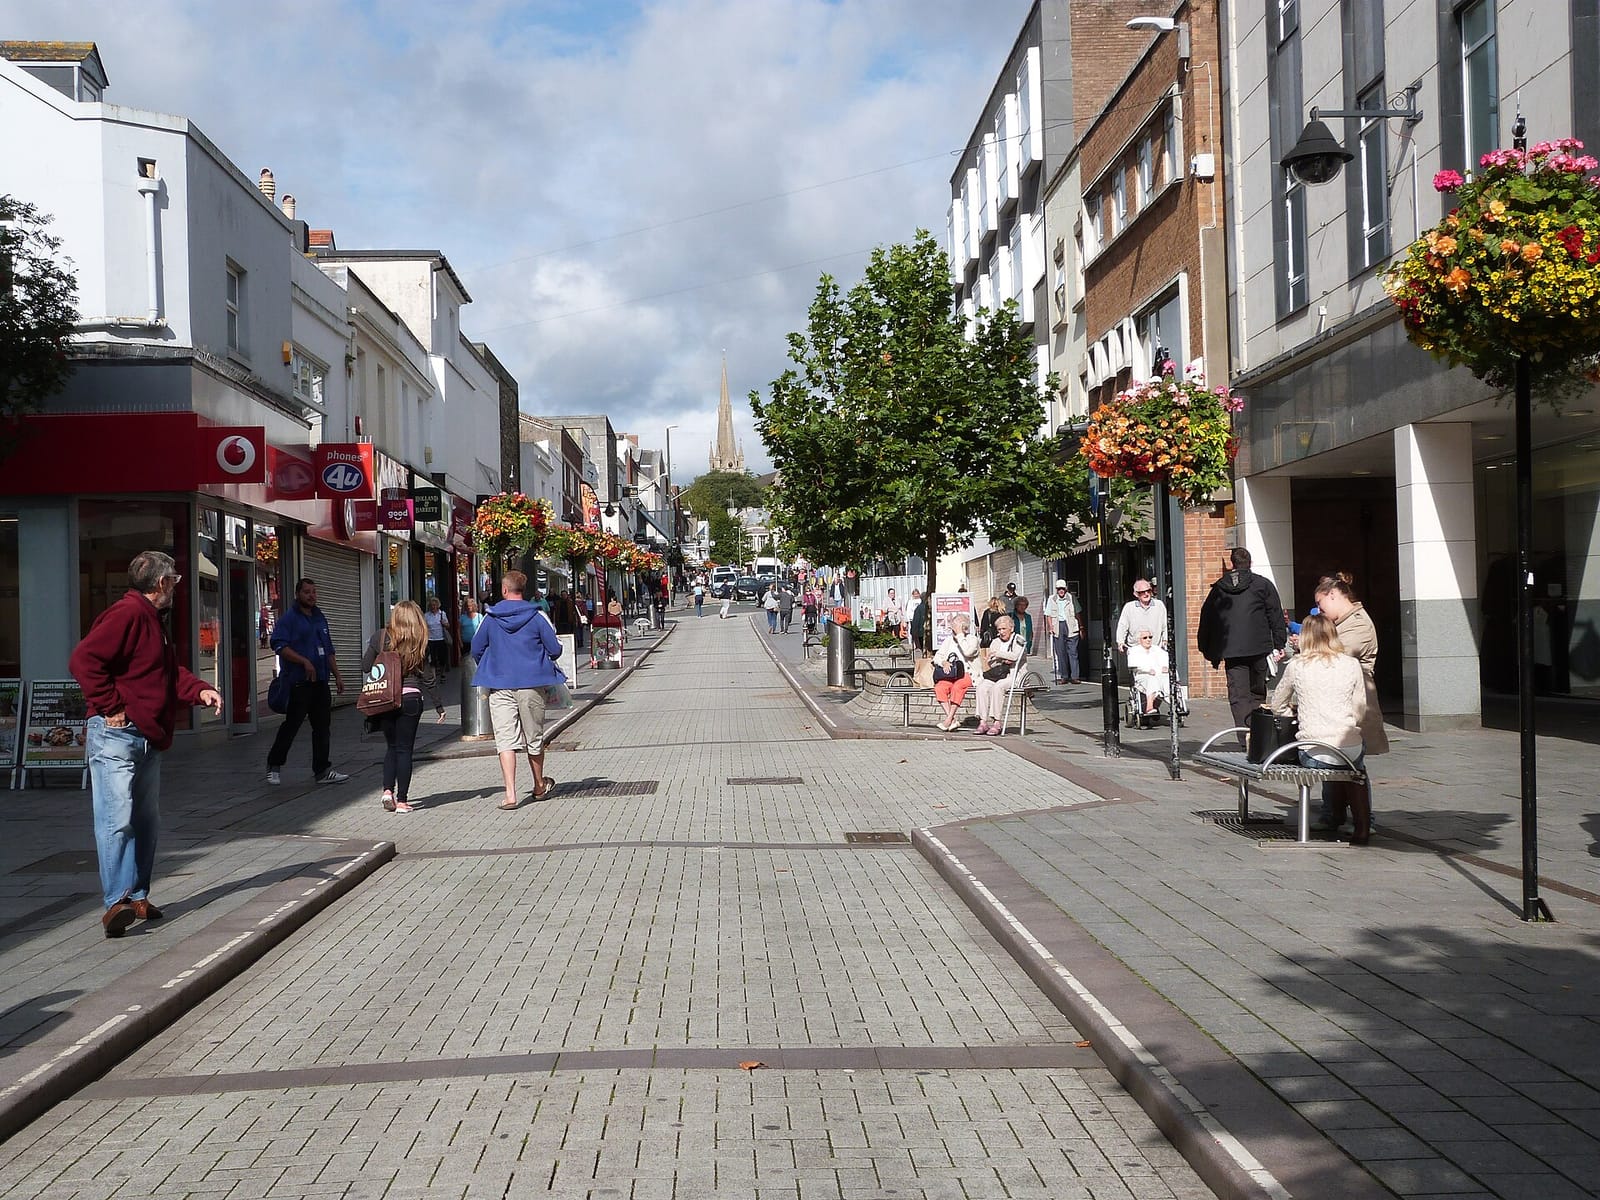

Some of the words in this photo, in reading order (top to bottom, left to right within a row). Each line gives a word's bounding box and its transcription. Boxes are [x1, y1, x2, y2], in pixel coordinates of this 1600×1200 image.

[327, 450, 363, 462] phones
[327, 465, 360, 489] 4u
[388, 509, 408, 519] good
[362, 680, 388, 692] animal
[56, 718, 87, 727] takeaway
